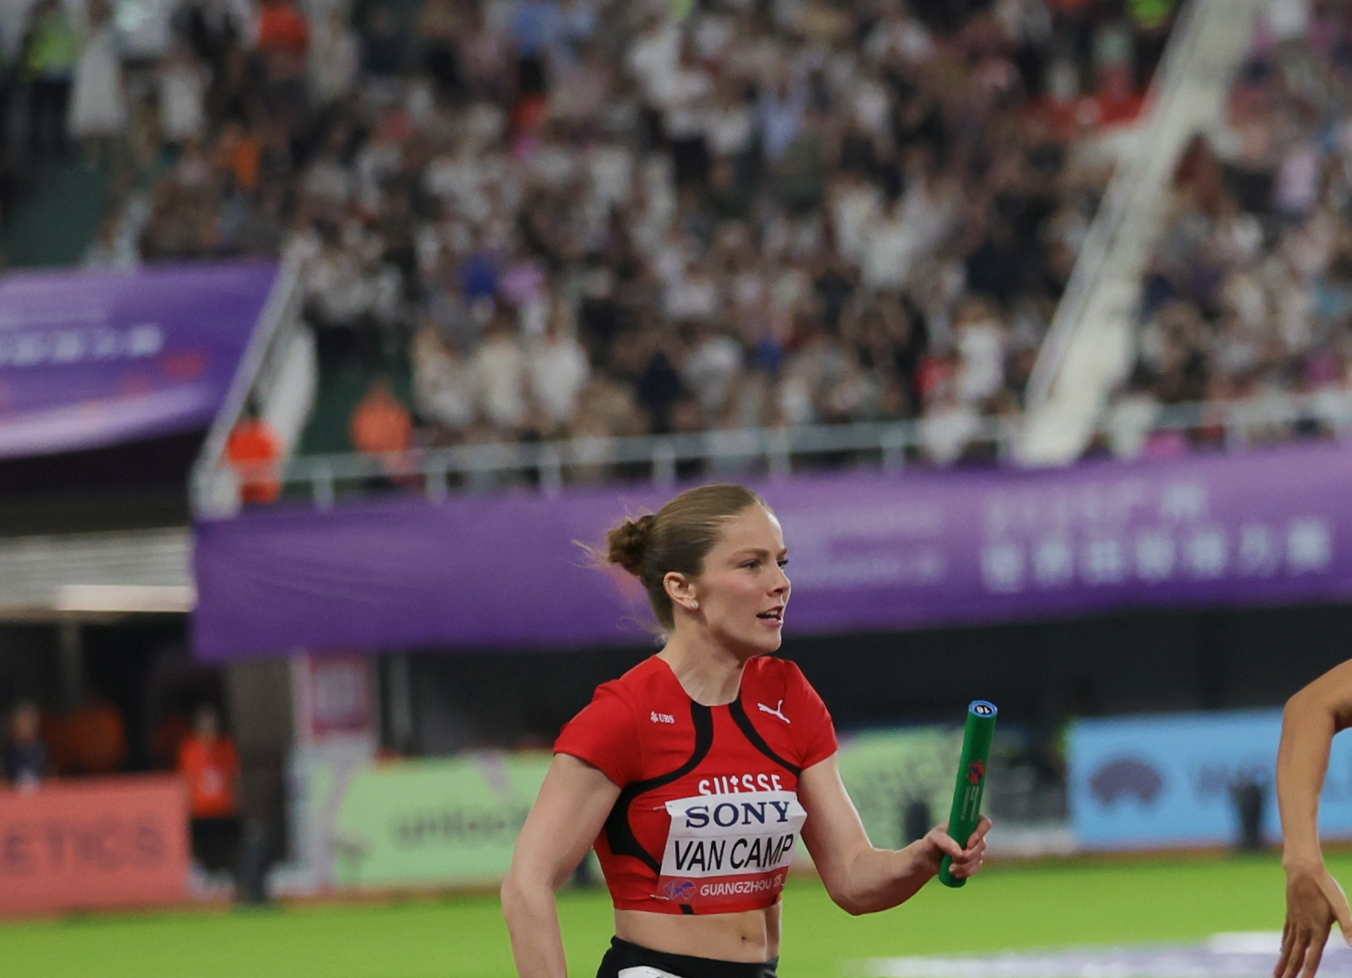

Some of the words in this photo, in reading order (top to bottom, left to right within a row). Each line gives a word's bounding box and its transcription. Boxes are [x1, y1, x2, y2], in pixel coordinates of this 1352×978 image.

[658, 713, 675, 724] UBS
[685, 801, 790, 828] SONY
[674, 840, 726, 872] VAN
[730, 833, 794, 869] CAMP
[700, 877, 772, 896] GUANGZHOU
